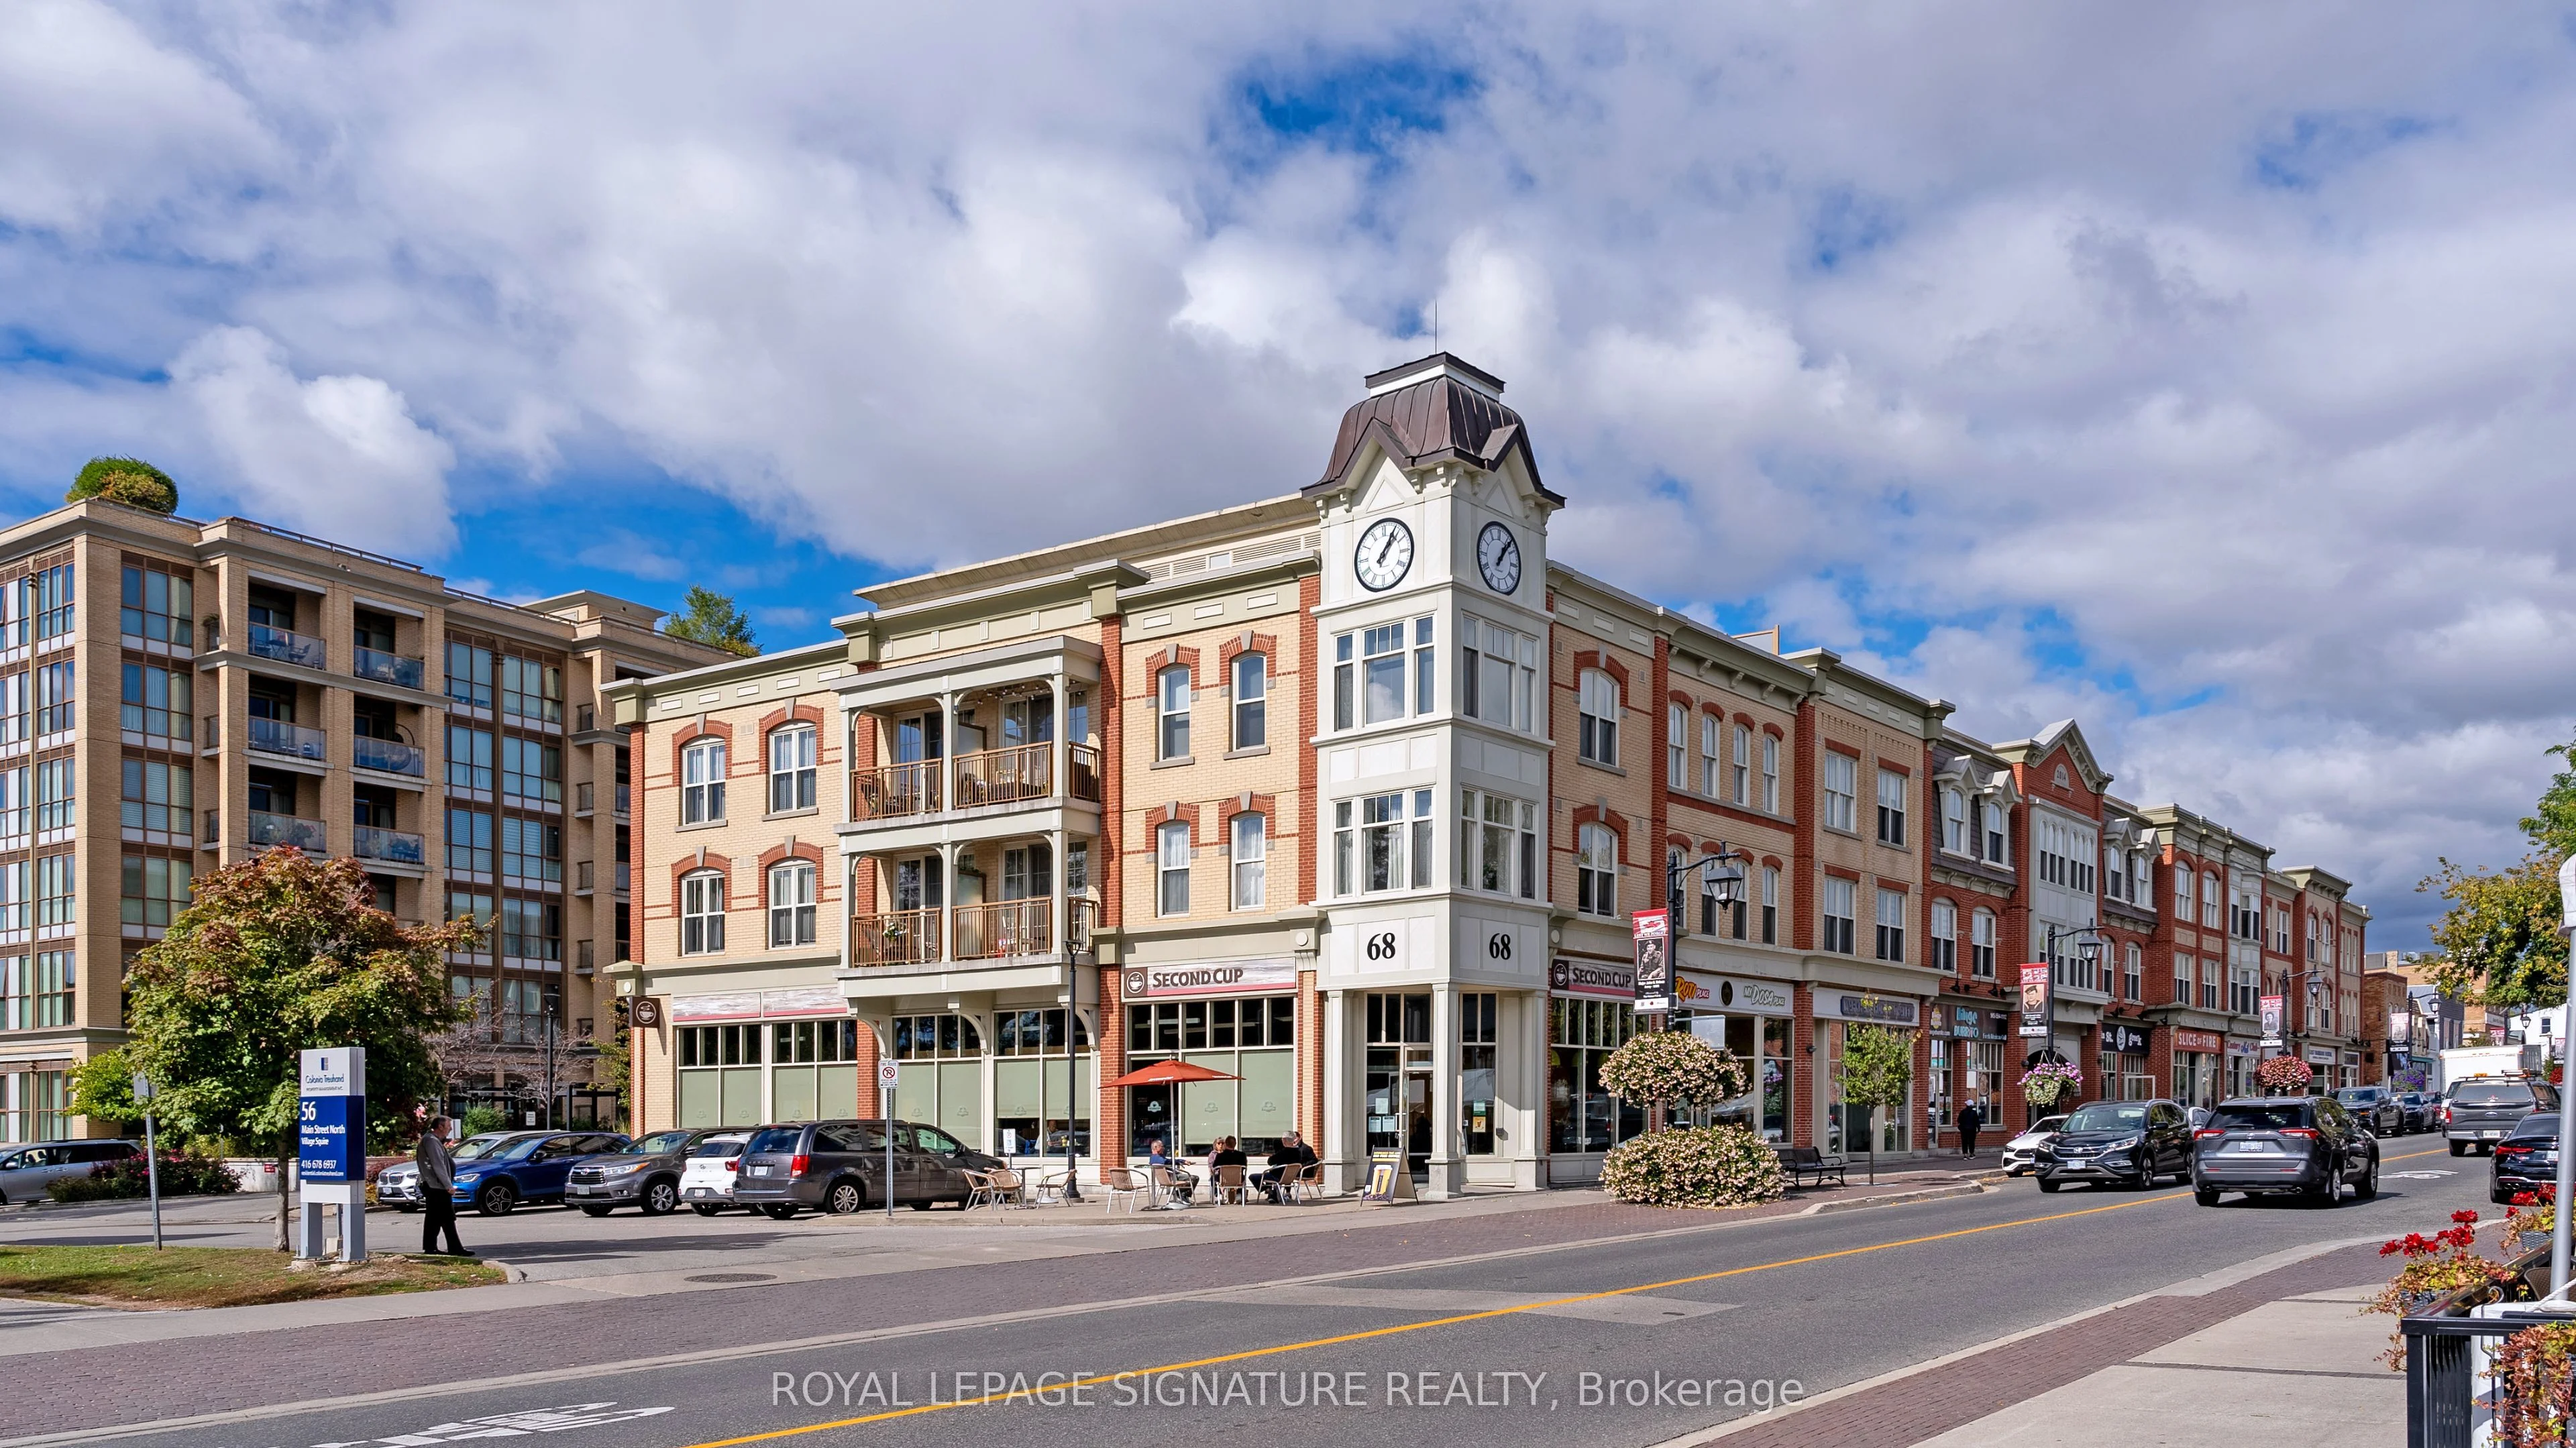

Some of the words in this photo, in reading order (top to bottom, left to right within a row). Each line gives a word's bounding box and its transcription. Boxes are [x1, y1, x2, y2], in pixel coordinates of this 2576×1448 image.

[1367, 933, 1395, 960] 68
[1489, 933, 1511, 960] 68
[1153, 971, 1211, 988] SECOND
[1213, 968, 1243, 984] CUP
[1572, 967, 1611, 986] SECOND
[1613, 971, 1631, 987] CUP
[1675, 976, 1697, 1003] ROTI
[1697, 987, 1709, 999] PLACE
[1752, 985, 1774, 1005] DOSA
[1773, 995, 1786, 1007] PLACE
[1953, 1025, 1979, 1038] BURRITO
[2178, 1033, 2196, 1046] SLICE
[2202, 1035, 2216, 1048] FIRE
[301, 1101, 317, 1121] 56
[301, 1125, 314, 1133] Main
[314, 1124, 329, 1133] Street
[329, 1124, 345, 1133] North
[301, 1160, 311, 1168] 416
[312, 1160, 323, 1168] 678
[323, 1160, 337, 1169] 6937
